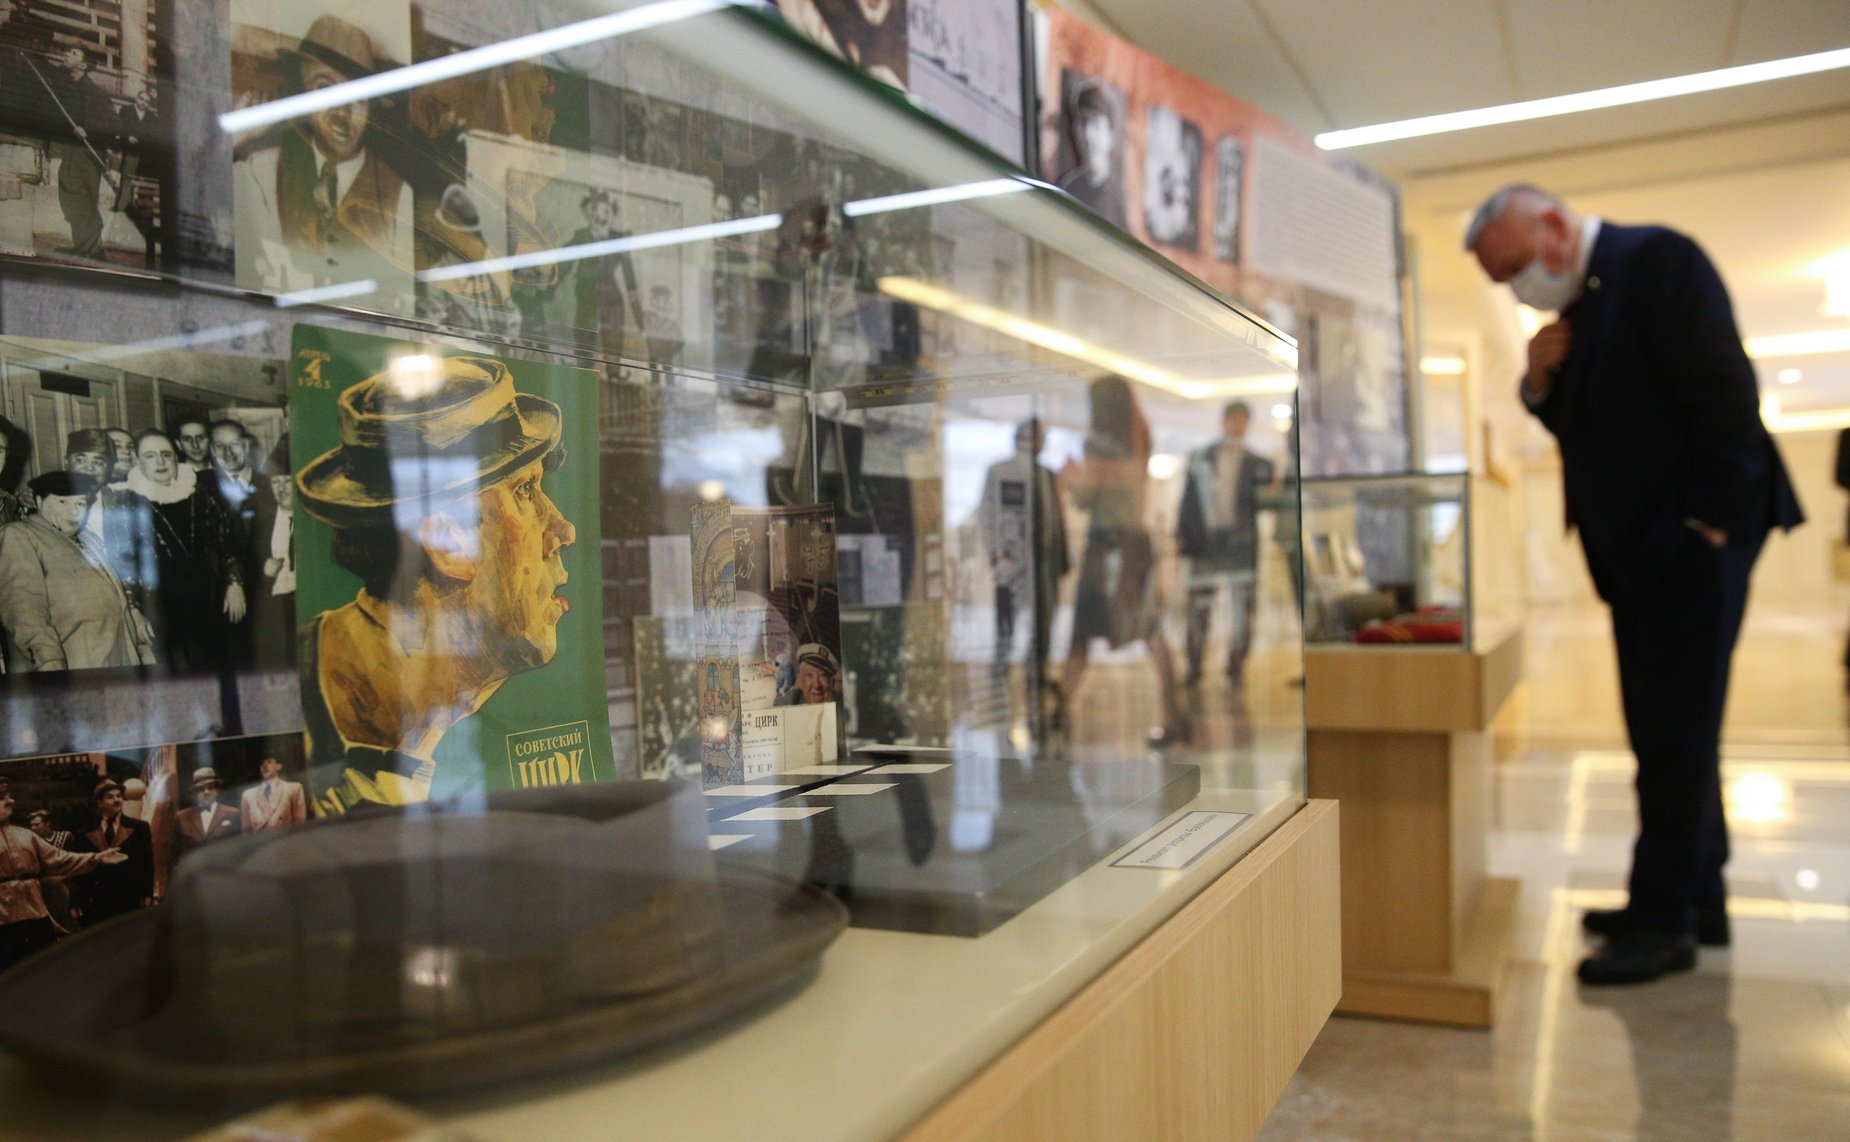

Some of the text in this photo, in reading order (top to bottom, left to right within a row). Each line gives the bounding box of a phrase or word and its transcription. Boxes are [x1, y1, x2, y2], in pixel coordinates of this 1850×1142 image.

[304, 358, 321, 380] 4
[755, 714, 778, 731] ЦИРК
[515, 729, 582, 757] СОВЕТСКИЙ
